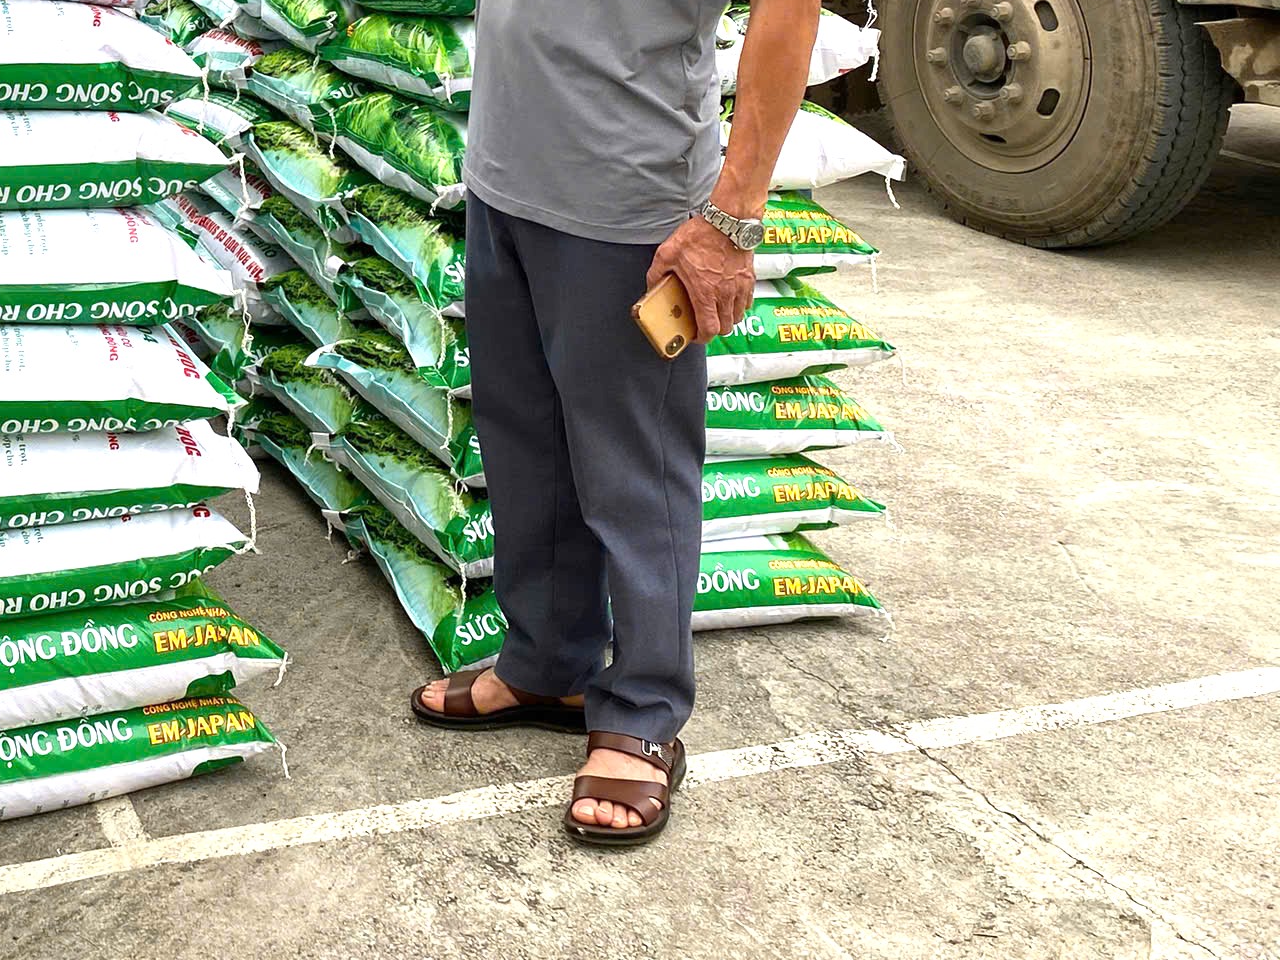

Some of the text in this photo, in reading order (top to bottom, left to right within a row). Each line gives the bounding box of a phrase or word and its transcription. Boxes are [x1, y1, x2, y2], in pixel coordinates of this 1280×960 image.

[55, 81, 122, 109] SỐNG
[16, 181, 73, 203] CHO
[78, 177, 143, 204] SỐNG
[764, 225, 864, 245] EM-JAPAN
[26, 301, 83, 321] CHO
[777, 322, 880, 343] EM-JAPAN
[774, 401, 870, 421] EM-JAPAN
[0, 418, 61, 435] CHO
[701, 472, 762, 503] ĐỒNG
[772, 481, 864, 504] EM-JAPAN
[7, 508, 65, 528] CHO
[697, 561, 761, 594] ĐỒNG
[772, 576, 870, 597] EM-JAPAN
[29, 588, 86, 611] CHO
[148, 610, 179, 624] CÔNG
[59, 618, 139, 657] ĐỒNG
[153, 623, 262, 654] EM-JAPAN
[454, 613, 500, 646] SỨC
[142, 703, 171, 716] CÔNG
[171, 699, 199, 712] NGHỆ
[56, 716, 134, 752] ĐỒNG
[147, 711, 257, 746] EM-JAPAN
